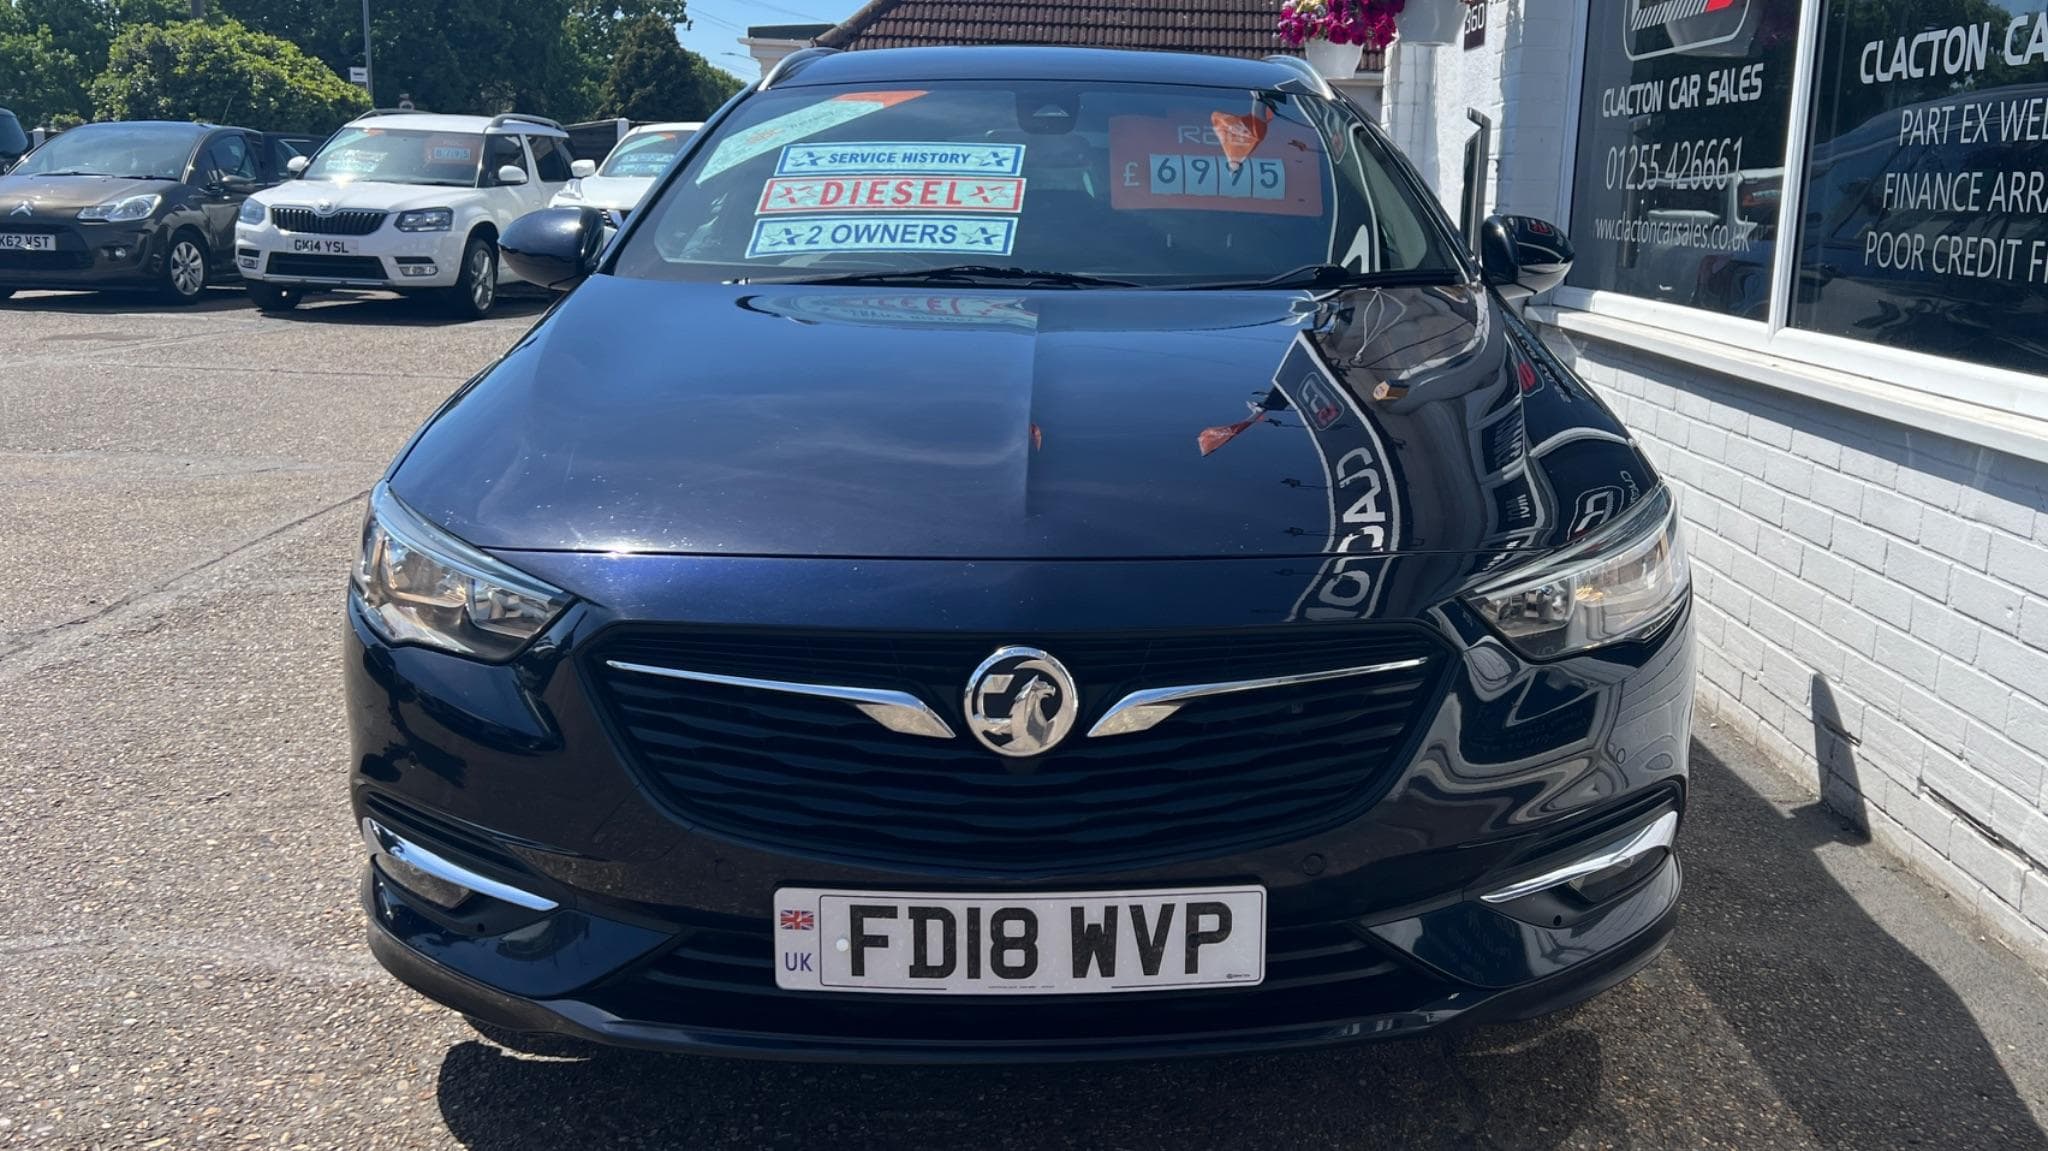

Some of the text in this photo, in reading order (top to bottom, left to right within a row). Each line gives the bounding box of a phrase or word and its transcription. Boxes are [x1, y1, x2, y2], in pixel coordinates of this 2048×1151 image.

[1860, 21, 1990, 84] CLACTON
[1602, 63, 1764, 117] CLACTON CAR SALES
[1899, 106, 1956, 146] PART
[1960, 102, 1992, 144] EX
[828, 152, 971, 164] SERVICE HISTORY
[1606, 136, 1743, 191] 01255 426661
[819, 180, 963, 206] DIESEL
[1883, 171, 2048, 213] FINANCE ARR
[294, 240, 349, 253] GK14 YSL
[804, 223, 958, 245] 2 OWNERS
[1592, 211, 1750, 251] ww.clactoncarsales.co.uk
[1865, 231, 1925, 271] POOR
[1932, 235, 2022, 280] CREDIT
[785, 952, 812, 971] UK
[850, 901, 1233, 980] FD18 WVP
